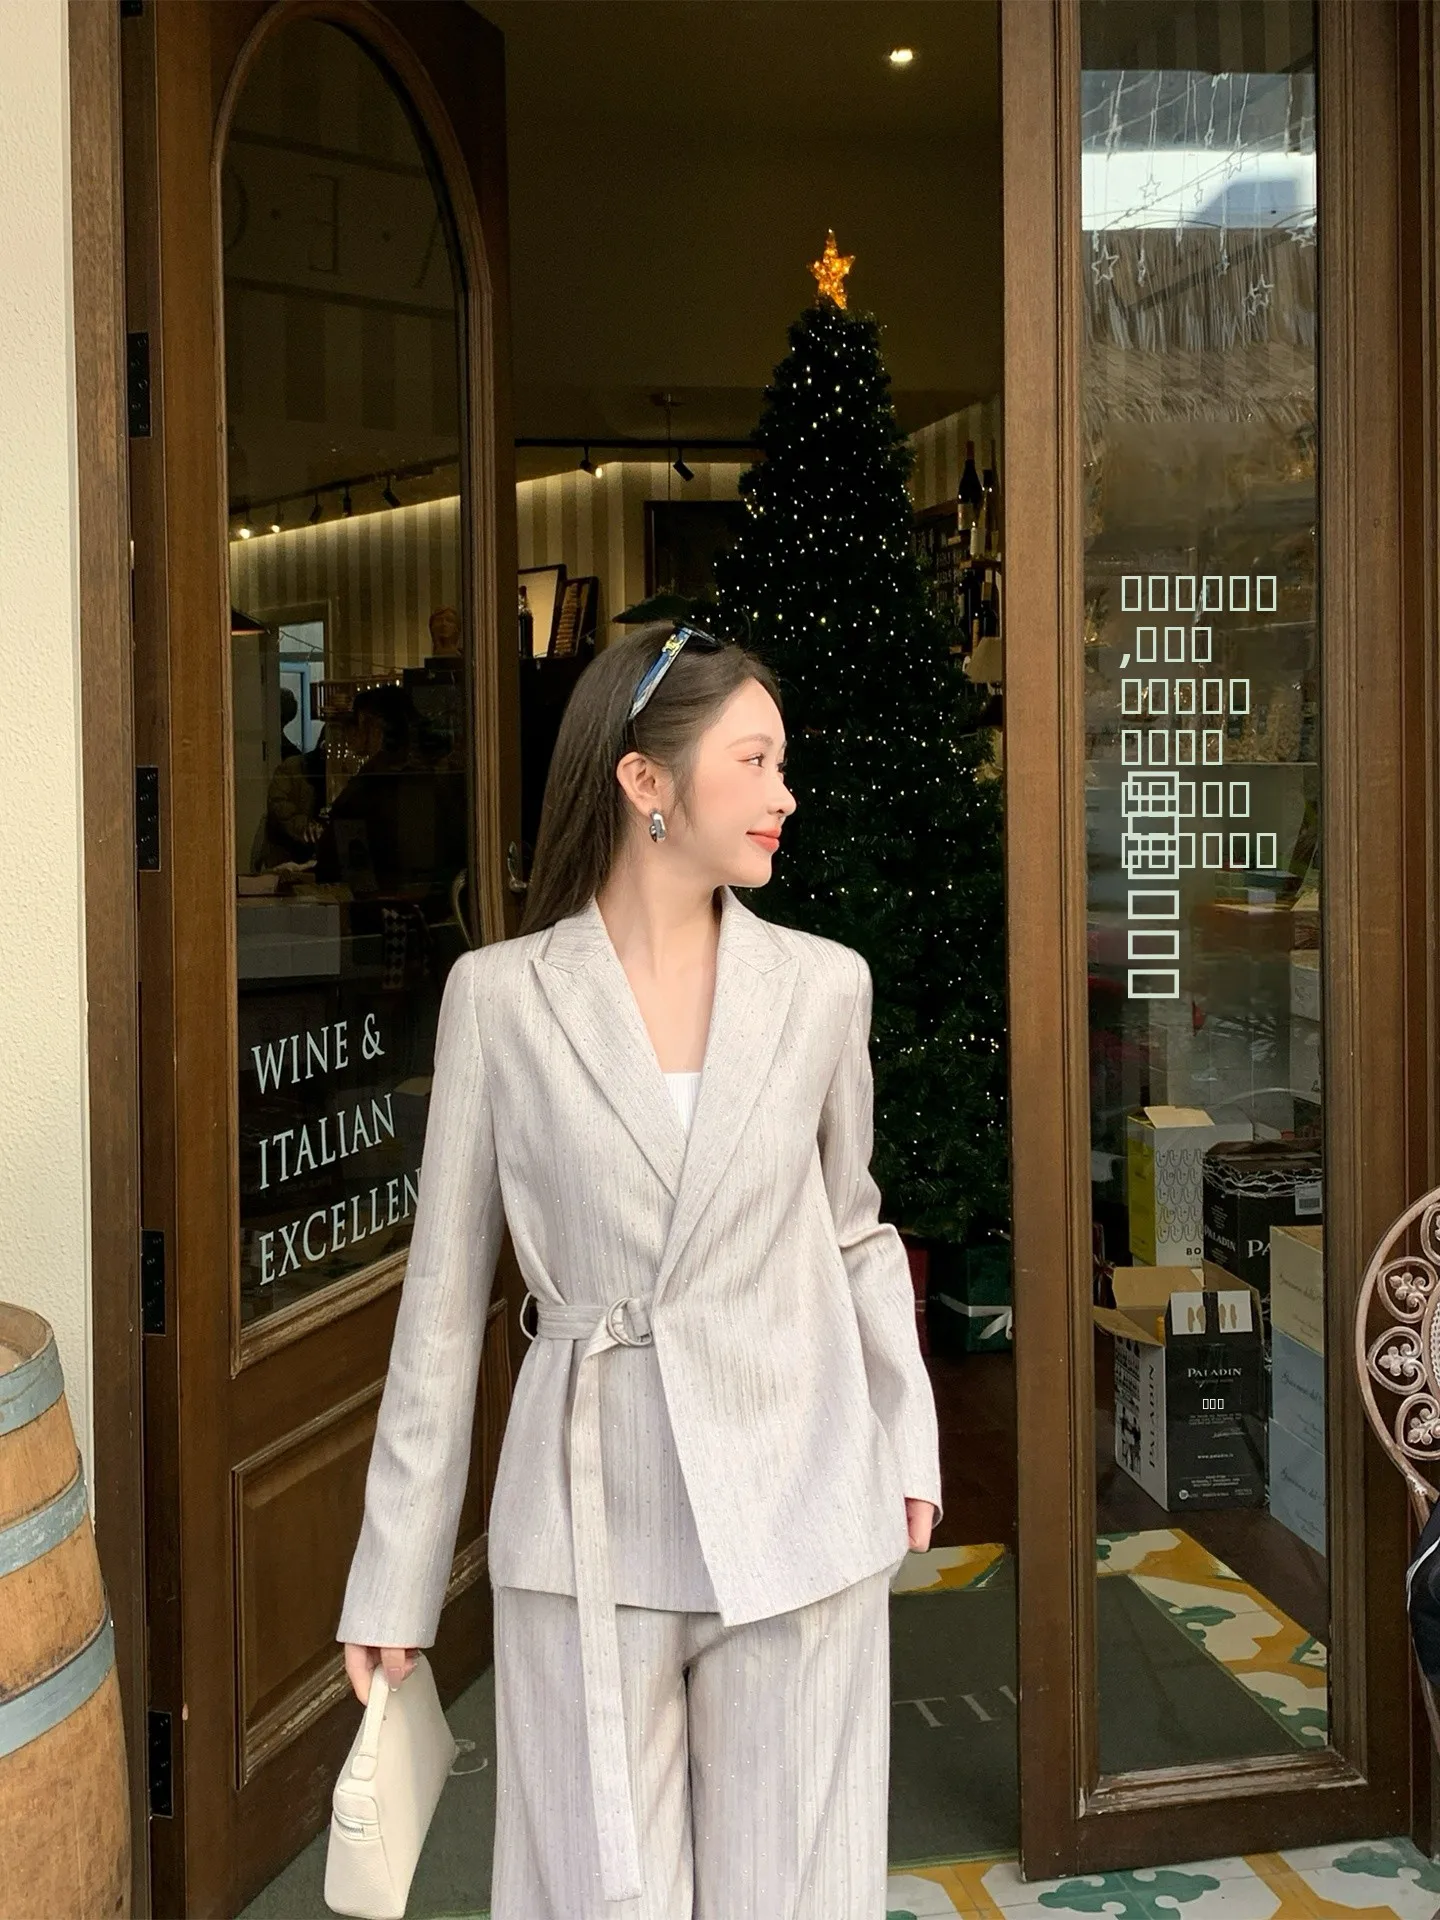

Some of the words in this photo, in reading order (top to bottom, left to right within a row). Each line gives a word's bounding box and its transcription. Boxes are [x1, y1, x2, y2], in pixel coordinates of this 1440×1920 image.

[251, 1021, 349, 1094] WINE
[361, 1013, 385, 1060] &
[259, 1093, 396, 1190] ITALIAN
[1187, 1367, 1242, 1378] PALADIN
